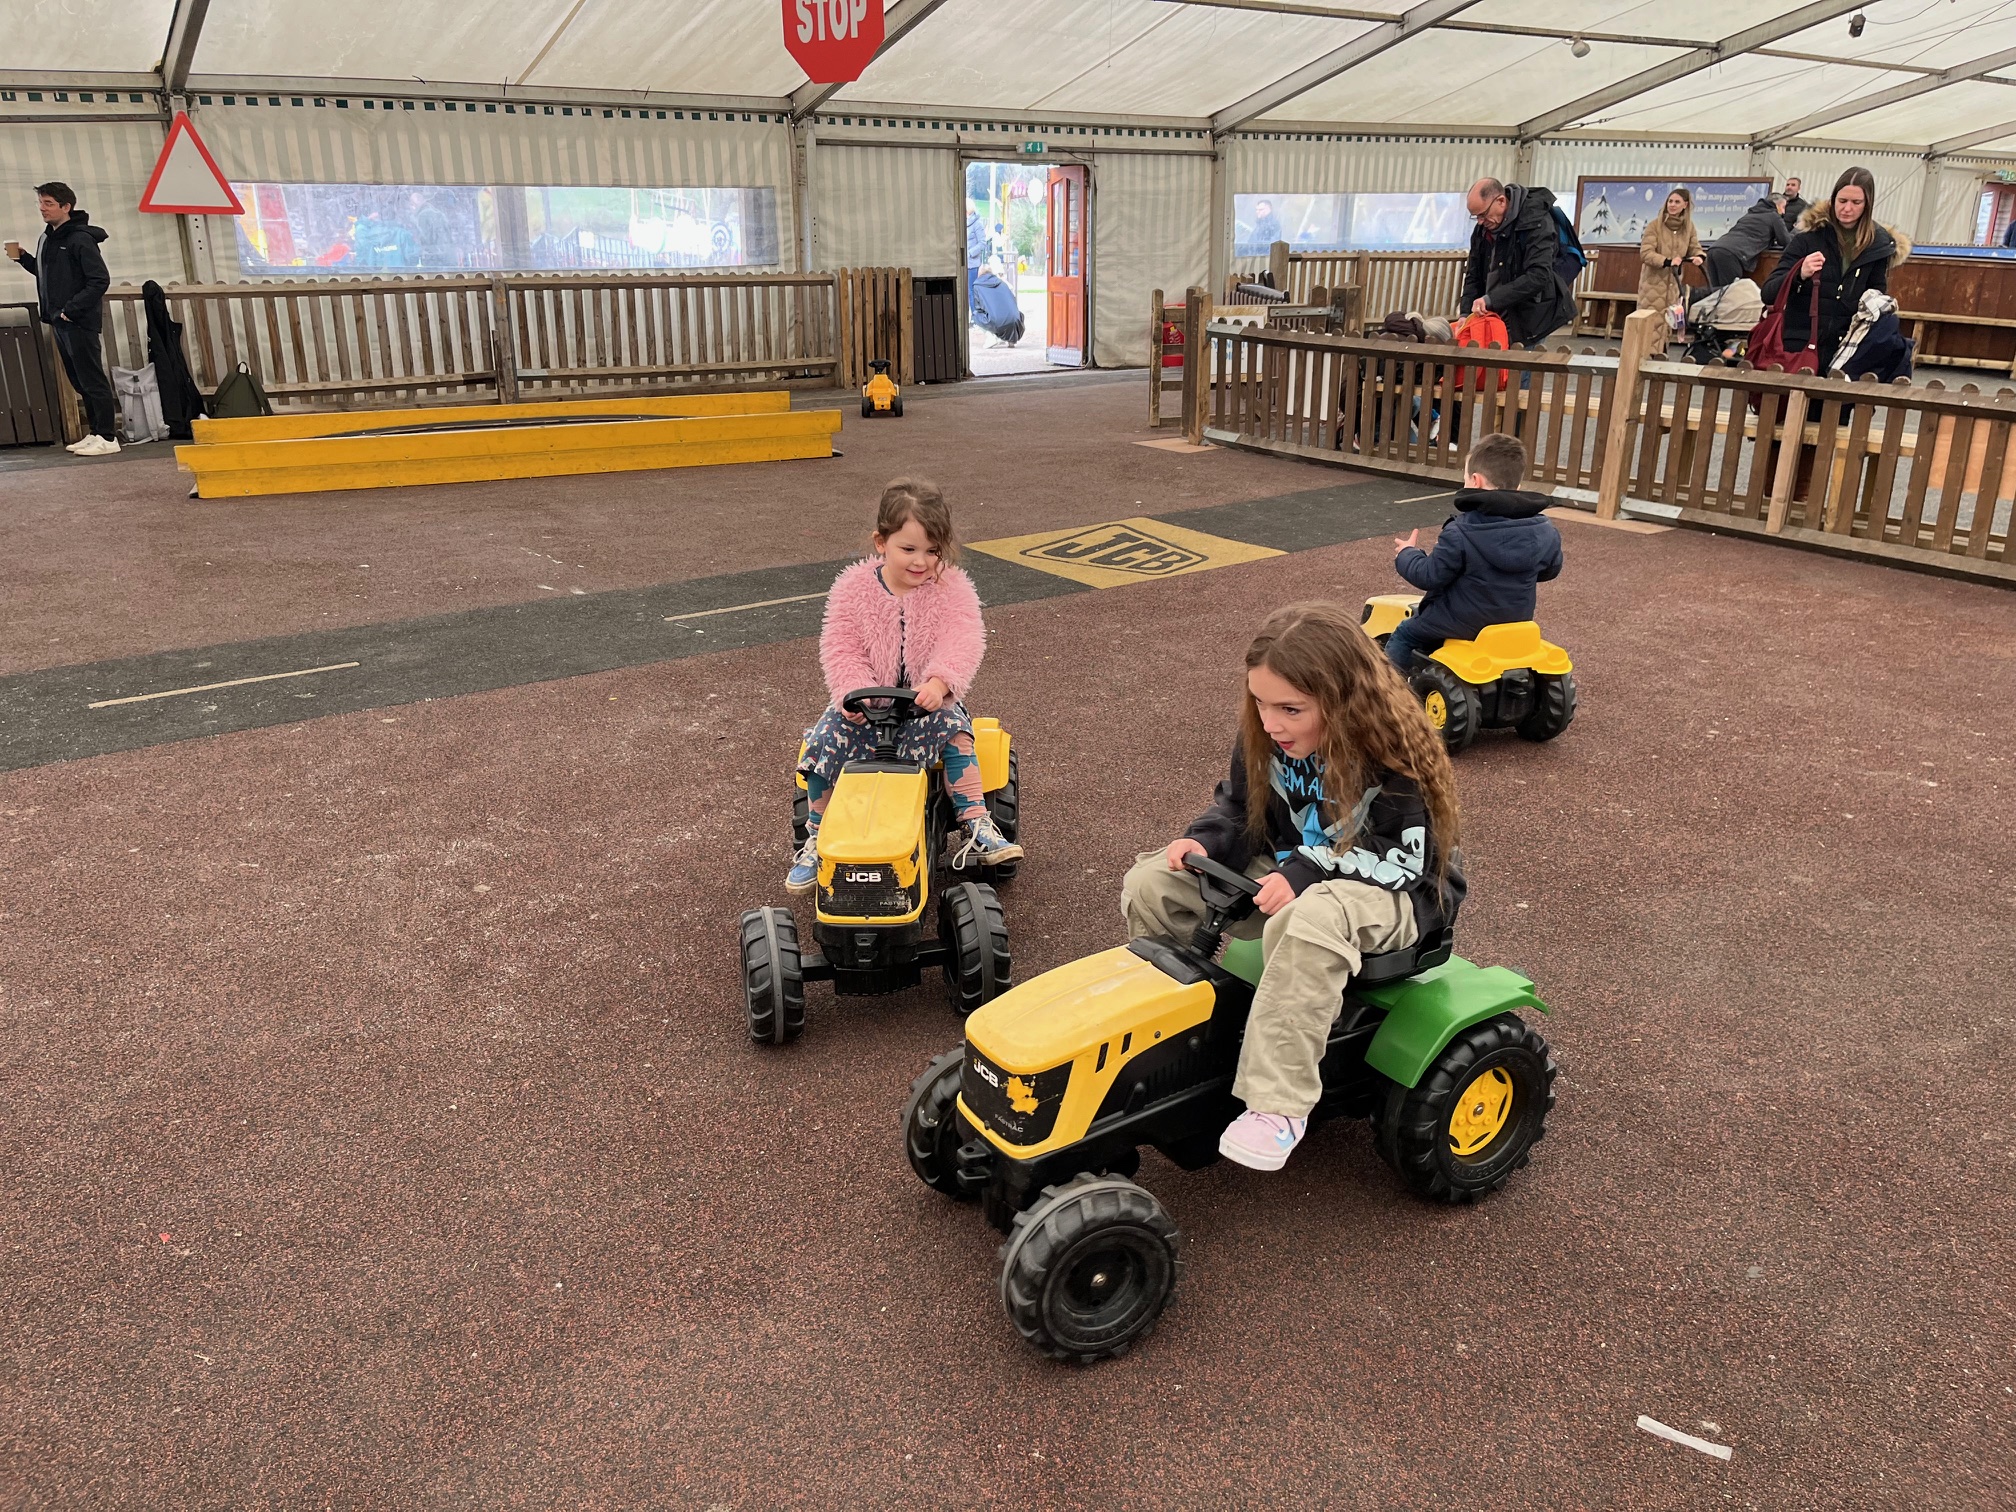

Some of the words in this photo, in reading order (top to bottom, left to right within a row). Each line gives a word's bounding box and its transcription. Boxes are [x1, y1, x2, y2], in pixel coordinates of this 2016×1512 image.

[796, 0, 867, 43] STOP
[1708, 194, 1723, 203] many
[1723, 193, 1747, 203] penguins
[1704, 206, 1715, 214] you
[1715, 204, 1726, 212] find
[1042, 532, 1193, 571] JCB
[845, 872, 882, 883] JCB
[973, 1057, 999, 1088] JCB
